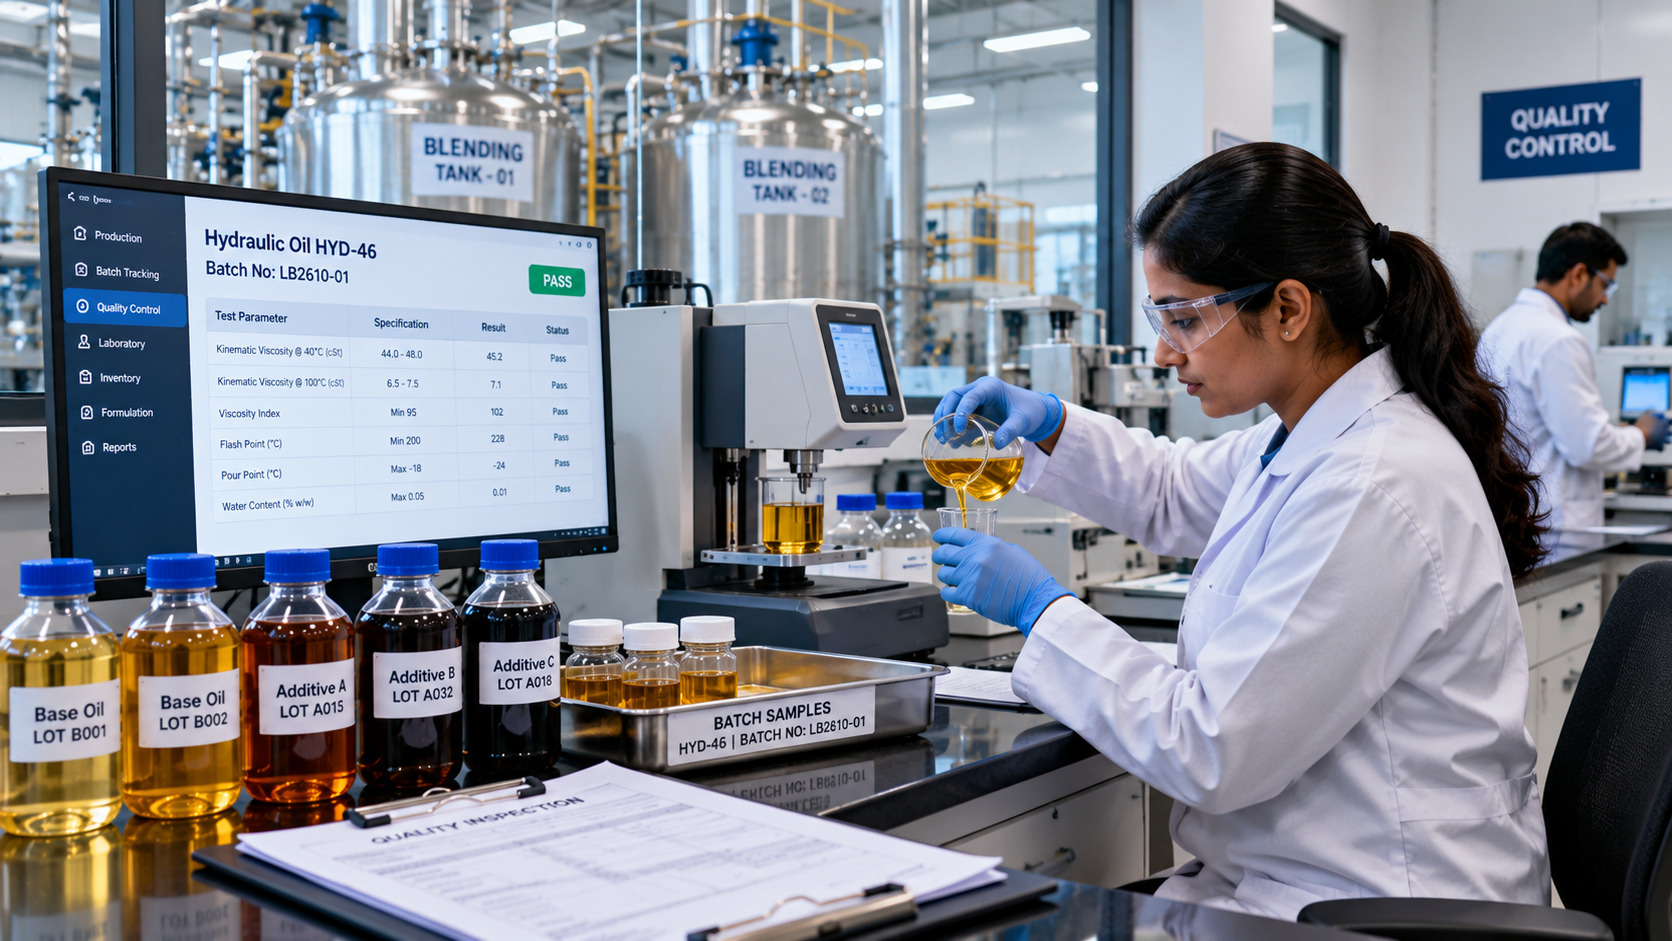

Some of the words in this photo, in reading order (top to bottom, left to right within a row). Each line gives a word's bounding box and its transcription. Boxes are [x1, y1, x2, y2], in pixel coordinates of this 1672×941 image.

[1510, 101, 1610, 132] QUALITY
[424, 137, 523, 162] BLENDING
[1505, 130, 1616, 160] CONTROL
[435, 164, 482, 182] TANK
[497, 168, 514, 186] 01
[744, 160, 837, 181] BLENDING
[752, 184, 797, 202] TANK
[811, 187, 829, 204] 02
[95, 230, 142, 244] Production
[205, 229, 285, 252] Hydraulic
[289, 236, 310, 254] Oil
[316, 238, 377, 259] HYD-46
[96, 266, 122, 278] Batch
[124, 268, 160, 281] Tracking
[206, 260, 247, 277] Batch
[252, 264, 276, 279] No:
[280, 265, 349, 284] LB2610-01
[543, 274, 572, 289] PASS
[97, 302, 128, 315] Quality
[130, 303, 160, 315] Control
[215, 310, 236, 322] Test
[238, 312, 288, 323] Parameter
[374, 317, 429, 330] Specification
[482, 323, 506, 333] Result
[546, 325, 569, 335] Status
[99, 338, 146, 350] Laboratory
[216, 344, 257, 354] Kinematic
[258, 346, 293, 357] Viscosity
[381, 350, 398, 358] 44.0
[406, 350, 423, 359] 48.0
[486, 352, 503, 361] 45.2
[550, 354, 566, 363] Pass
[100, 373, 141, 385] Inventory
[218, 377, 257, 386] Kinematic
[259, 377, 294, 388] Viscosity
[387, 379, 399, 388] 6.5
[407, 379, 419, 388] 7.5
[491, 380, 502, 389] 7.1
[551, 381, 568, 390] Pass
[102, 408, 153, 418] Formulation
[219, 409, 256, 420] Viscosity
[258, 409, 281, 418] Index
[391, 408, 404, 417] Min
[407, 408, 417, 417] 95
[491, 407, 504, 416] 102
[553, 407, 568, 416] Pass
[390, 437, 404, 445] Min
[406, 436, 421, 445] 200
[491, 434, 505, 443] 228
[554, 433, 569, 442] Pass
[103, 442, 137, 454] Reports
[220, 440, 242, 449] Flash
[245, 440, 265, 449] Point
[391, 465, 407, 474] Max
[409, 464, 422, 473] -18
[493, 461, 506, 470] -24
[554, 459, 570, 468] Pass
[221, 471, 241, 480] Pour
[243, 470, 265, 479] Point
[493, 488, 507, 497] 0.01
[555, 485, 571, 493] Pass
[391, 493, 407, 502] Max
[408, 492, 424, 501] 0.05
[222, 502, 247, 511] Water
[249, 500, 281, 510] Content
[283, 499, 294, 509] (%
[295, 498, 314, 508] w/w)
[493, 657, 546, 672] Additive
[547, 655, 555, 668] C
[389, 668, 446, 684] Additive
[448, 666, 455, 680] B
[276, 681, 336, 698] Additive
[339, 679, 347, 693] A
[498, 677, 522, 690] LOT
[525, 675, 552, 689] A018
[161, 695, 201, 710] Base
[206, 690, 225, 706] Oil
[393, 689, 420, 703] LOT
[423, 686, 453, 701] A032
[35, 706, 79, 722] Base
[84, 701, 105, 718] Oil
[280, 705, 309, 718] LOT
[313, 700, 344, 717] A015
[714, 711, 762, 730] BATCH
[766, 701, 831, 723] SAMPLES
[159, 716, 189, 731] LOT
[194, 712, 228, 729] B002
[33, 729, 66, 744] LOT
[71, 724, 106, 742] B001
[679, 737, 727, 755] HYD-46
[740, 728, 781, 746] BATCH
[785, 726, 806, 739] NO:
[371, 821, 459, 844] QUALITY
[463, 796, 585, 827] INSPECTION
